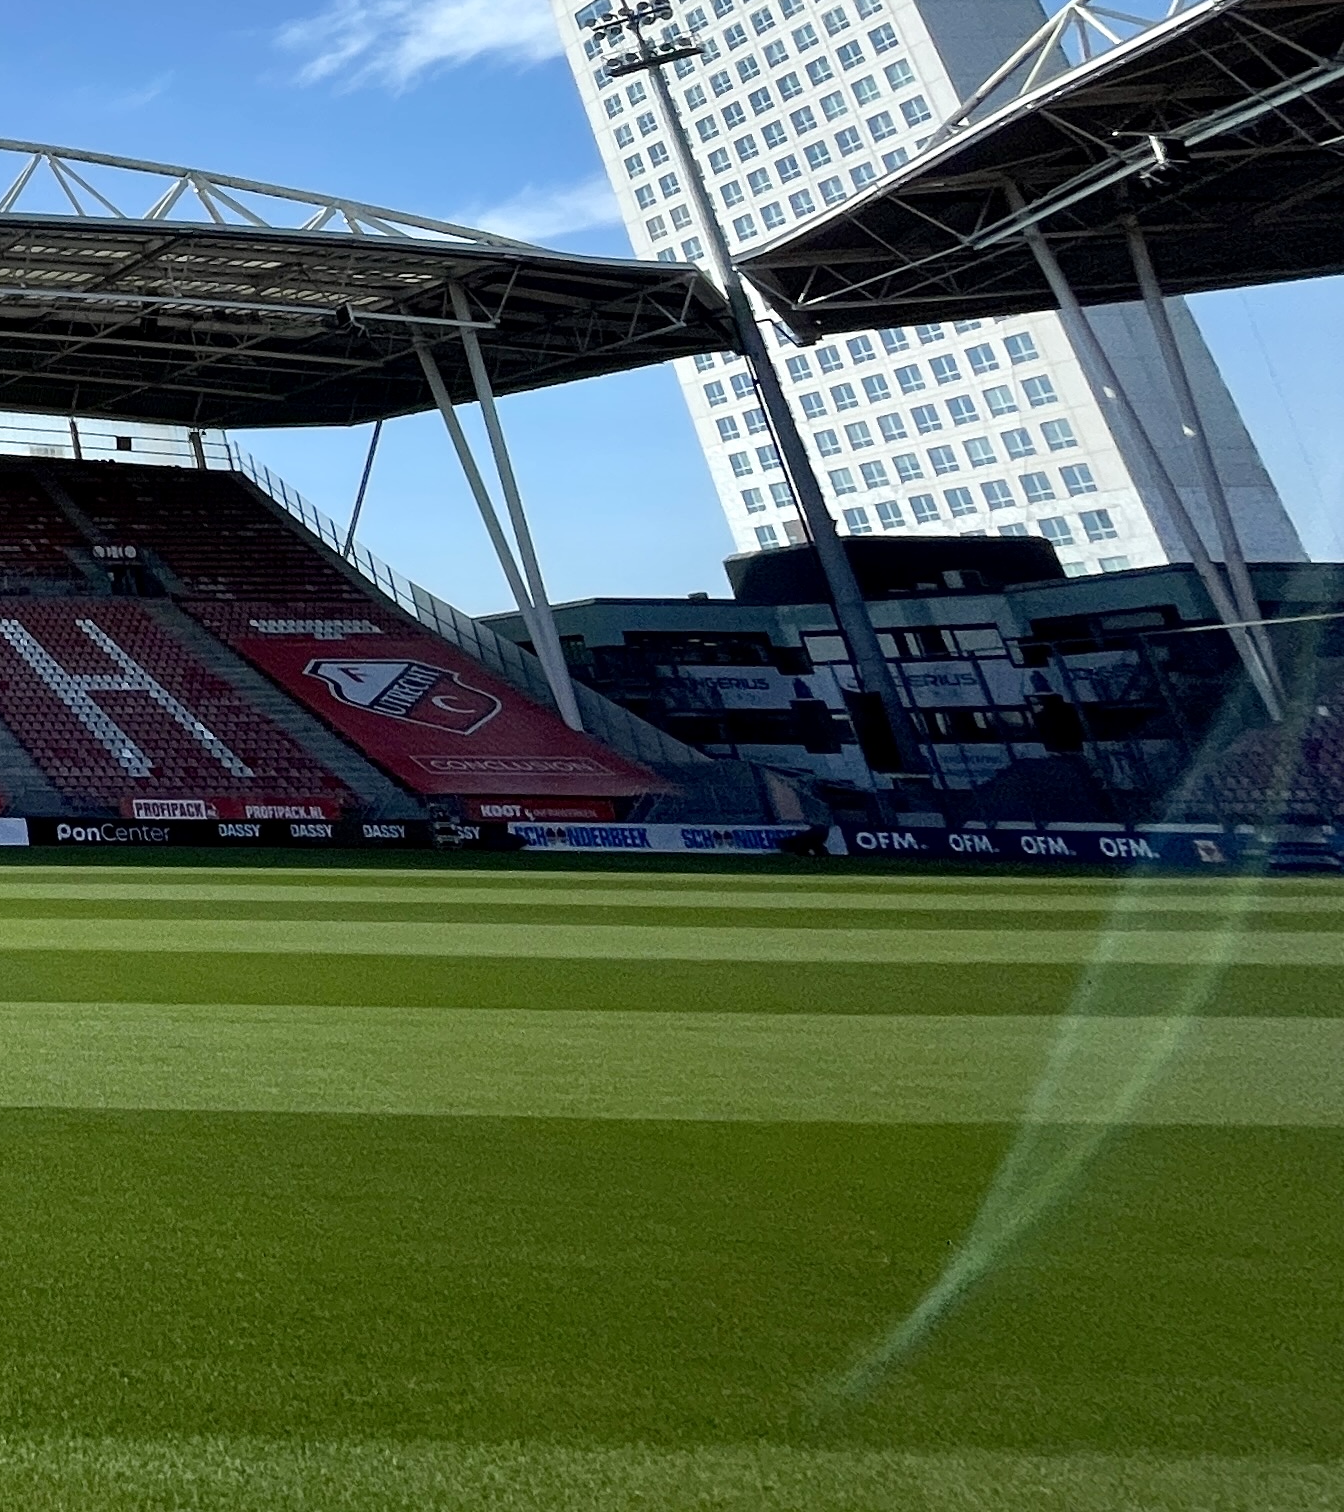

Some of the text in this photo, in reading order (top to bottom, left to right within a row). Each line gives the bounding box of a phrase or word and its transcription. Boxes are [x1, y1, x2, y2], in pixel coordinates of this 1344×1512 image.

[372, 665, 442, 716] UTRECHT
[429, 759, 594, 772] CONCLUSION
[135, 801, 326, 819] PROFIPACK PROFIPACK.NL
[480, 804, 522, 818] KOOT
[56, 823, 170, 841] PonCenter
[218, 824, 480, 840] DASSY DASSY DASSY SSY
